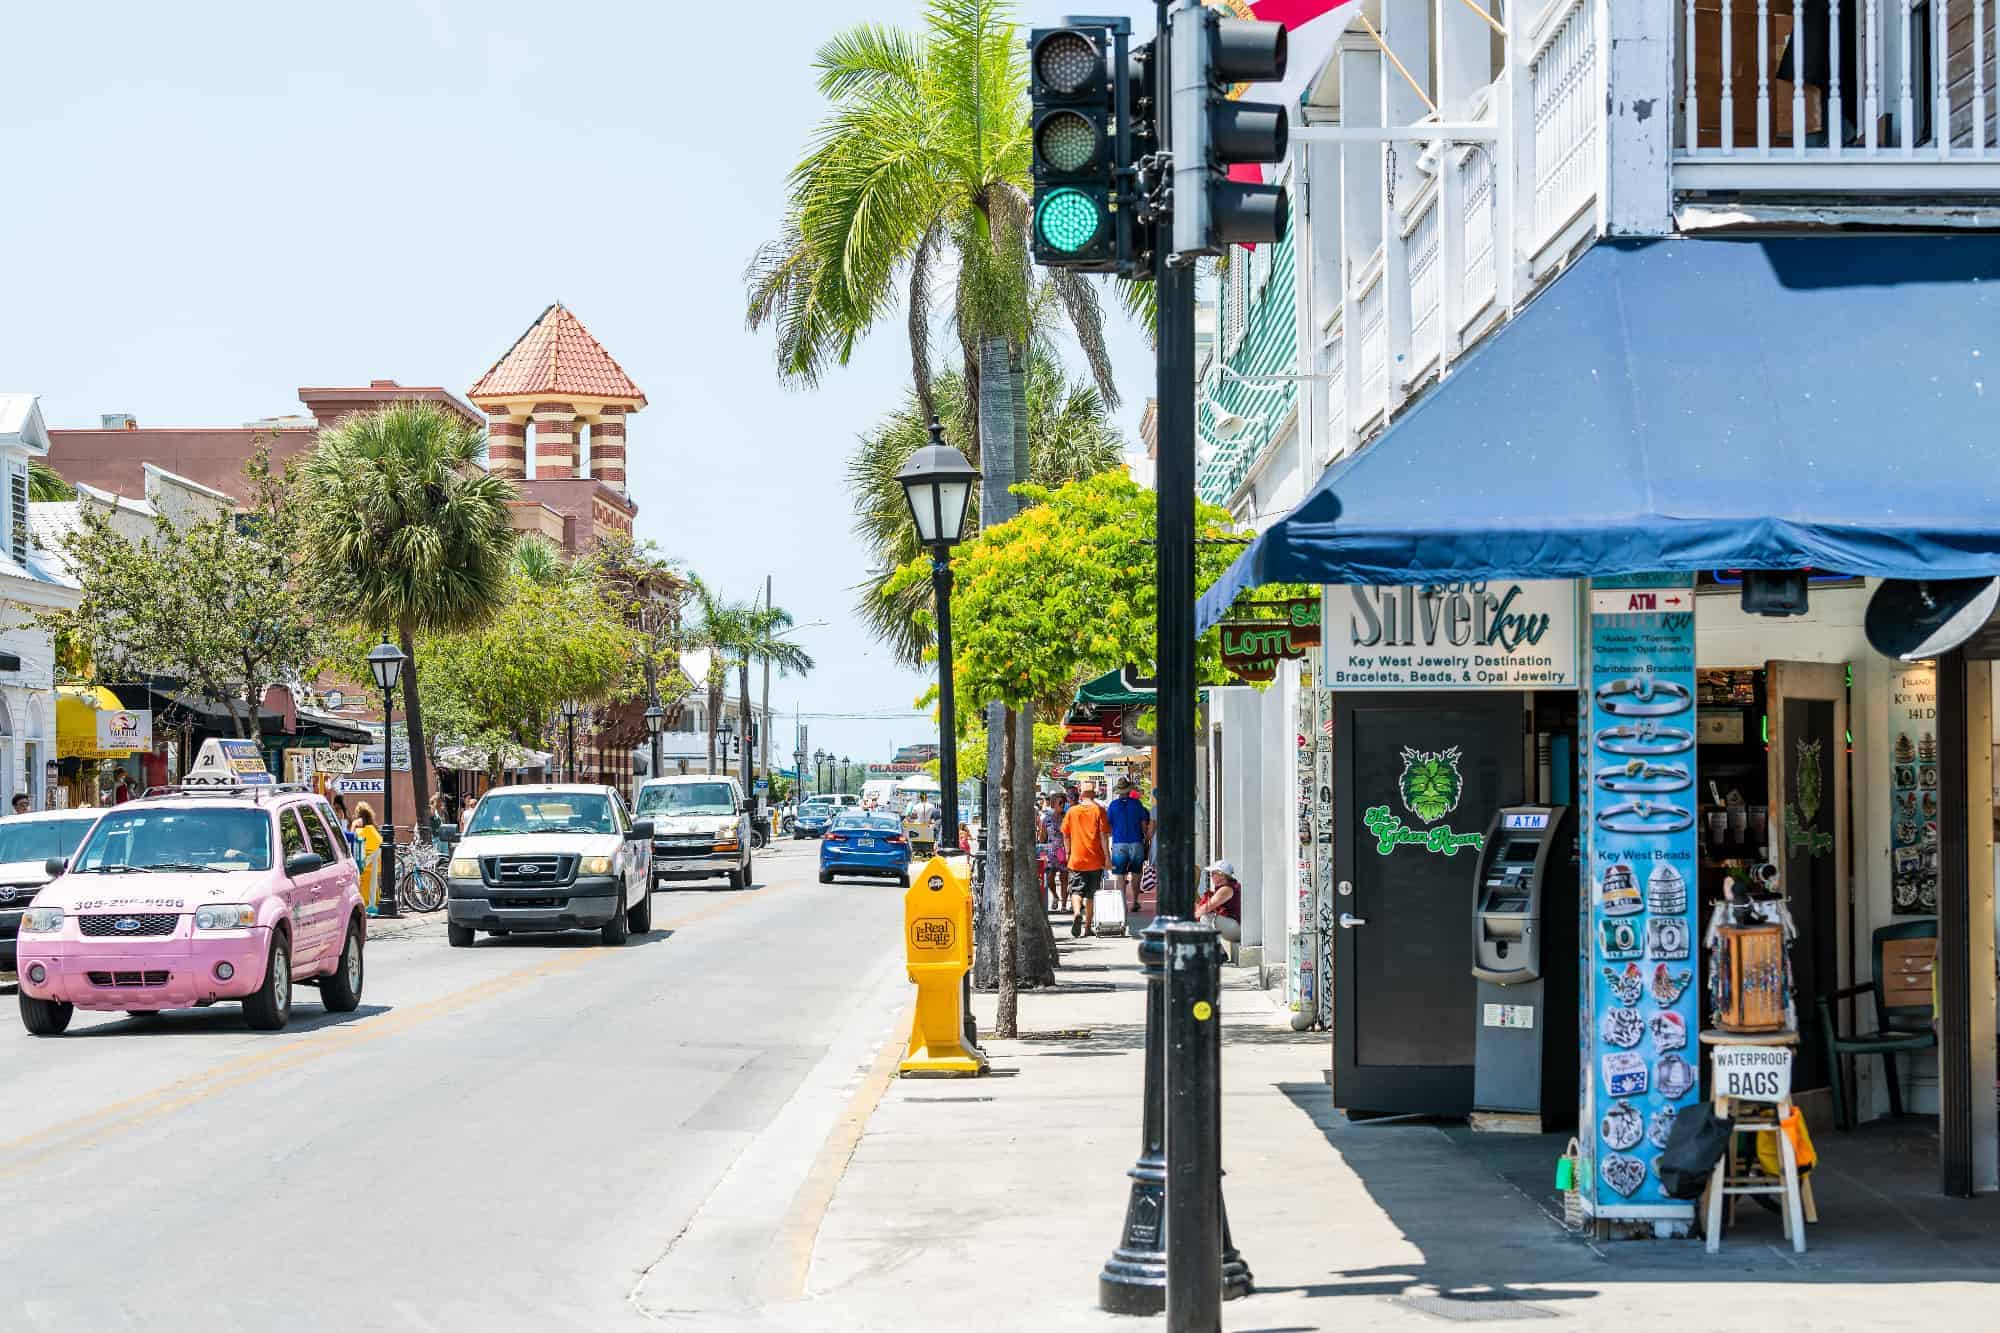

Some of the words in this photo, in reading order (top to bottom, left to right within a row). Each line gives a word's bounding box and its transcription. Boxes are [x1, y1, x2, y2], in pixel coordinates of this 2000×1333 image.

[1628, 593, 1656, 610] ATM
[1352, 584, 1500, 647] Silver
[1349, 656, 1374, 669] Key
[1379, 656, 1412, 667] West
[1417, 656, 1468, 669] Jewelry
[1474, 655, 1552, 667] Destination
[1336, 671, 1404, 683] Bracelets,
[1410, 671, 1456, 683] Beads,
[1462, 671, 1472, 682] &
[1477, 671, 1508, 684] Opal
[1513, 671, 1566, 683] Jewelry
[203, 754, 214, 766] 21
[870, 764, 926, 773] GLASSBO
[183, 777, 236, 785] TAXI
[340, 781, 380, 791] PARK
[1365, 806, 1400, 825] The
[1513, 815, 1542, 828] ATM
[1372, 823, 1428, 854] Green
[1427, 825, 1487, 856] Room
[1598, 850, 1619, 861] Key
[1623, 850, 1651, 860] West
[1655, 850, 1690, 860] Beads
[924, 921, 948, 933] Real
[1717, 1052, 1789, 1067] WATERPROOF
[1728, 1071, 1779, 1095] BAGS
